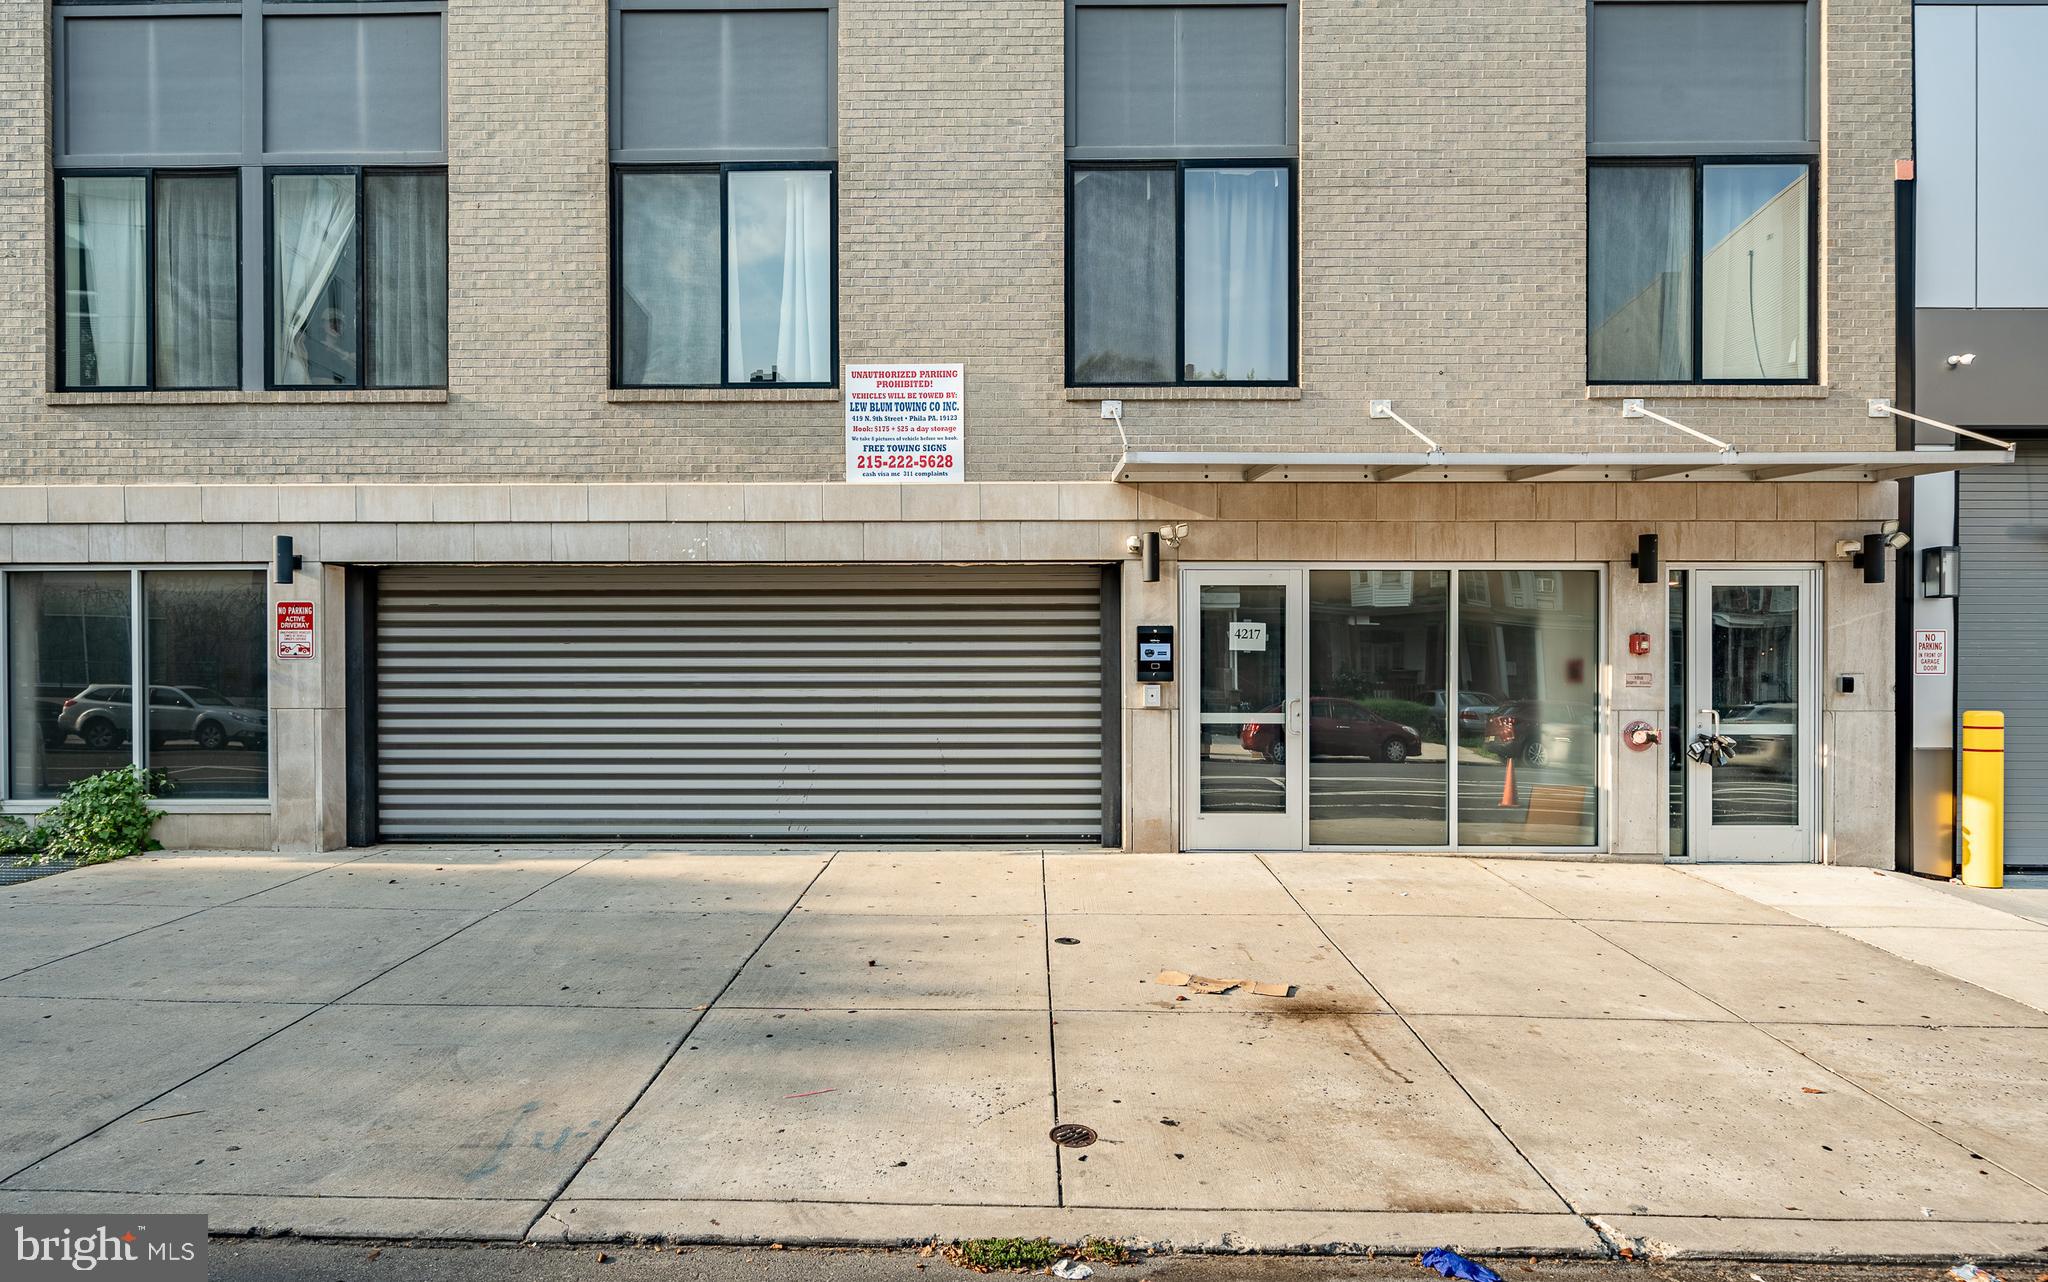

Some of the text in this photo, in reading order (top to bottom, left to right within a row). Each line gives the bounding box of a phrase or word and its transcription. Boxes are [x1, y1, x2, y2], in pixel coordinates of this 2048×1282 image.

[851, 370, 916, 378] UNAUTHORIZED
[850, 402, 959, 412] LEW BLUM TOWING CO INC.
[857, 455, 953, 468] 215-222-5628
[278, 606, 312, 614] NO PARKING
[1234, 629, 1261, 639] 4217
